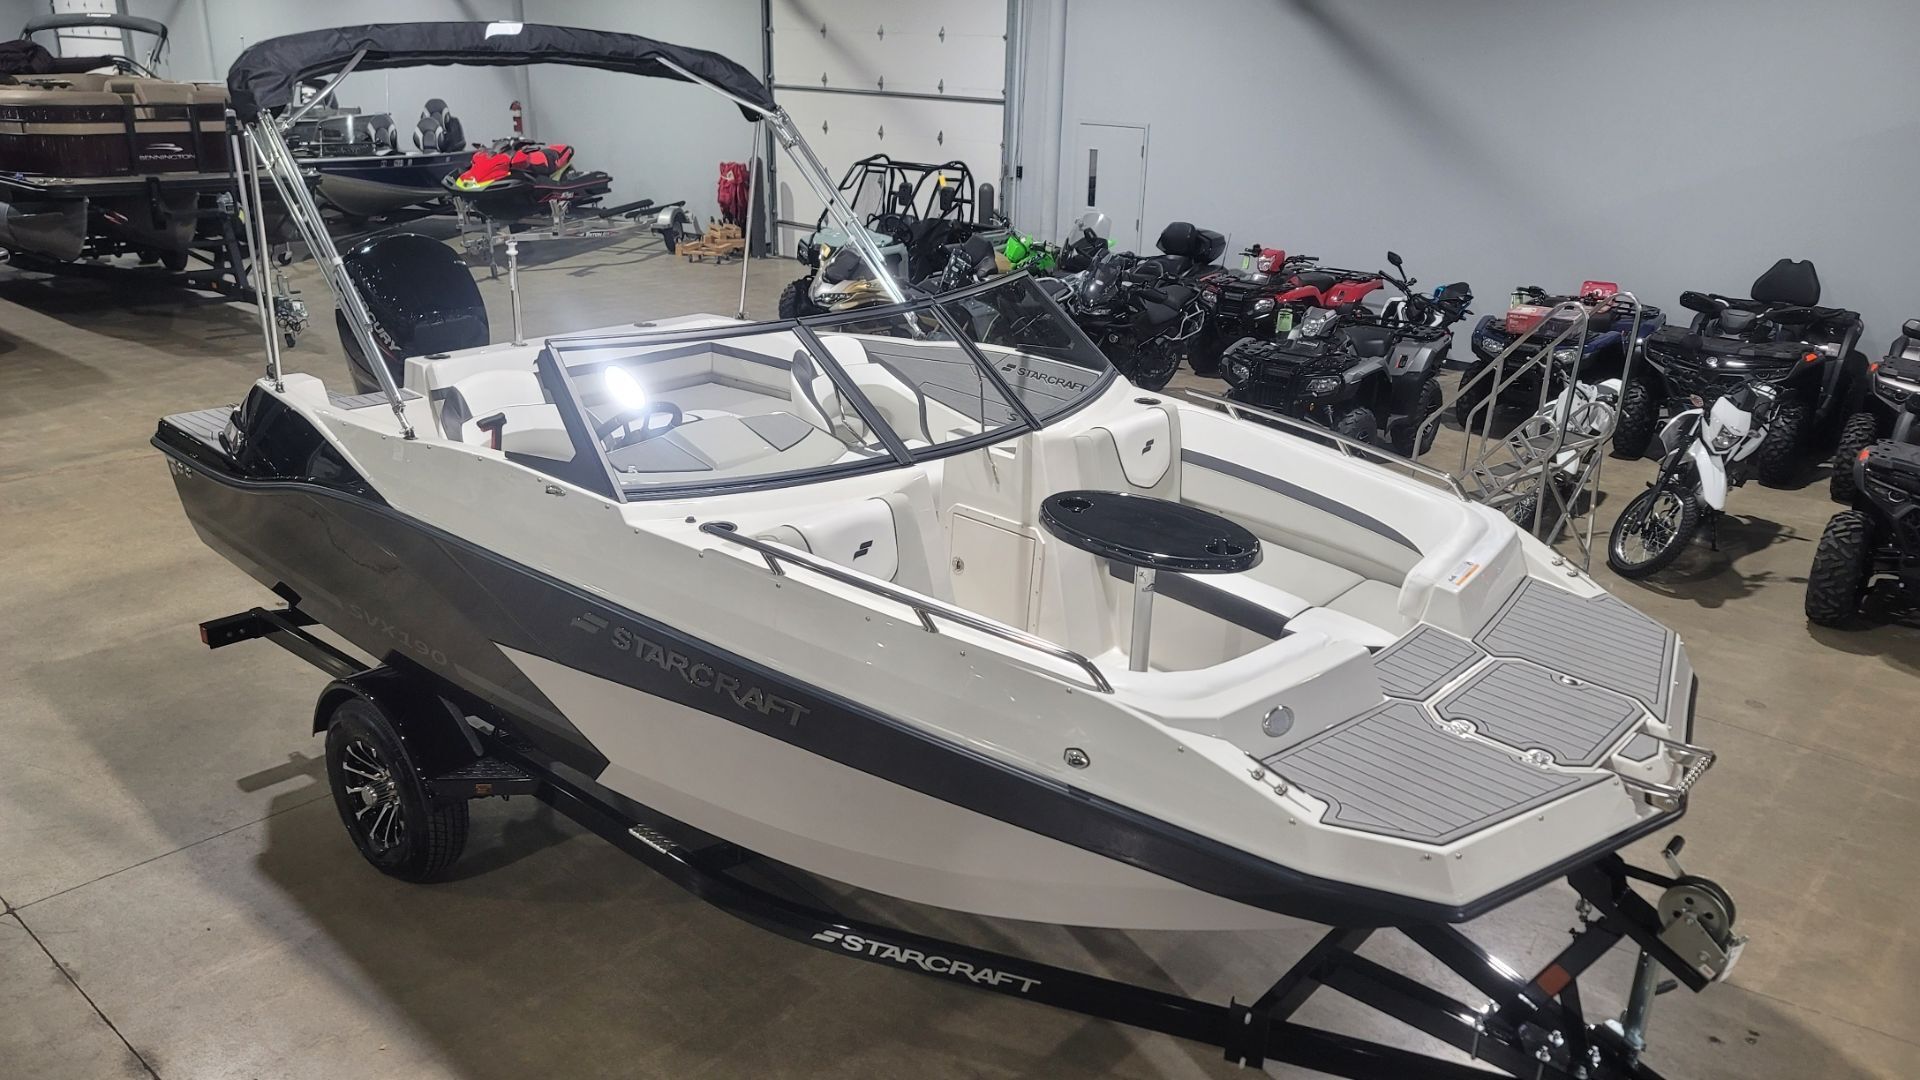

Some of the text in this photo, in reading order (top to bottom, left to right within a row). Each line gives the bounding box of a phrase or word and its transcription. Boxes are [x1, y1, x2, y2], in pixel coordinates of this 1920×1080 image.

[1017, 367, 1088, 392] STARCRAFT
[350, 604, 447, 665] SVX190
[612, 626, 811, 727] STARCRAFT
[841, 935, 1042, 993] STARCRAFT
